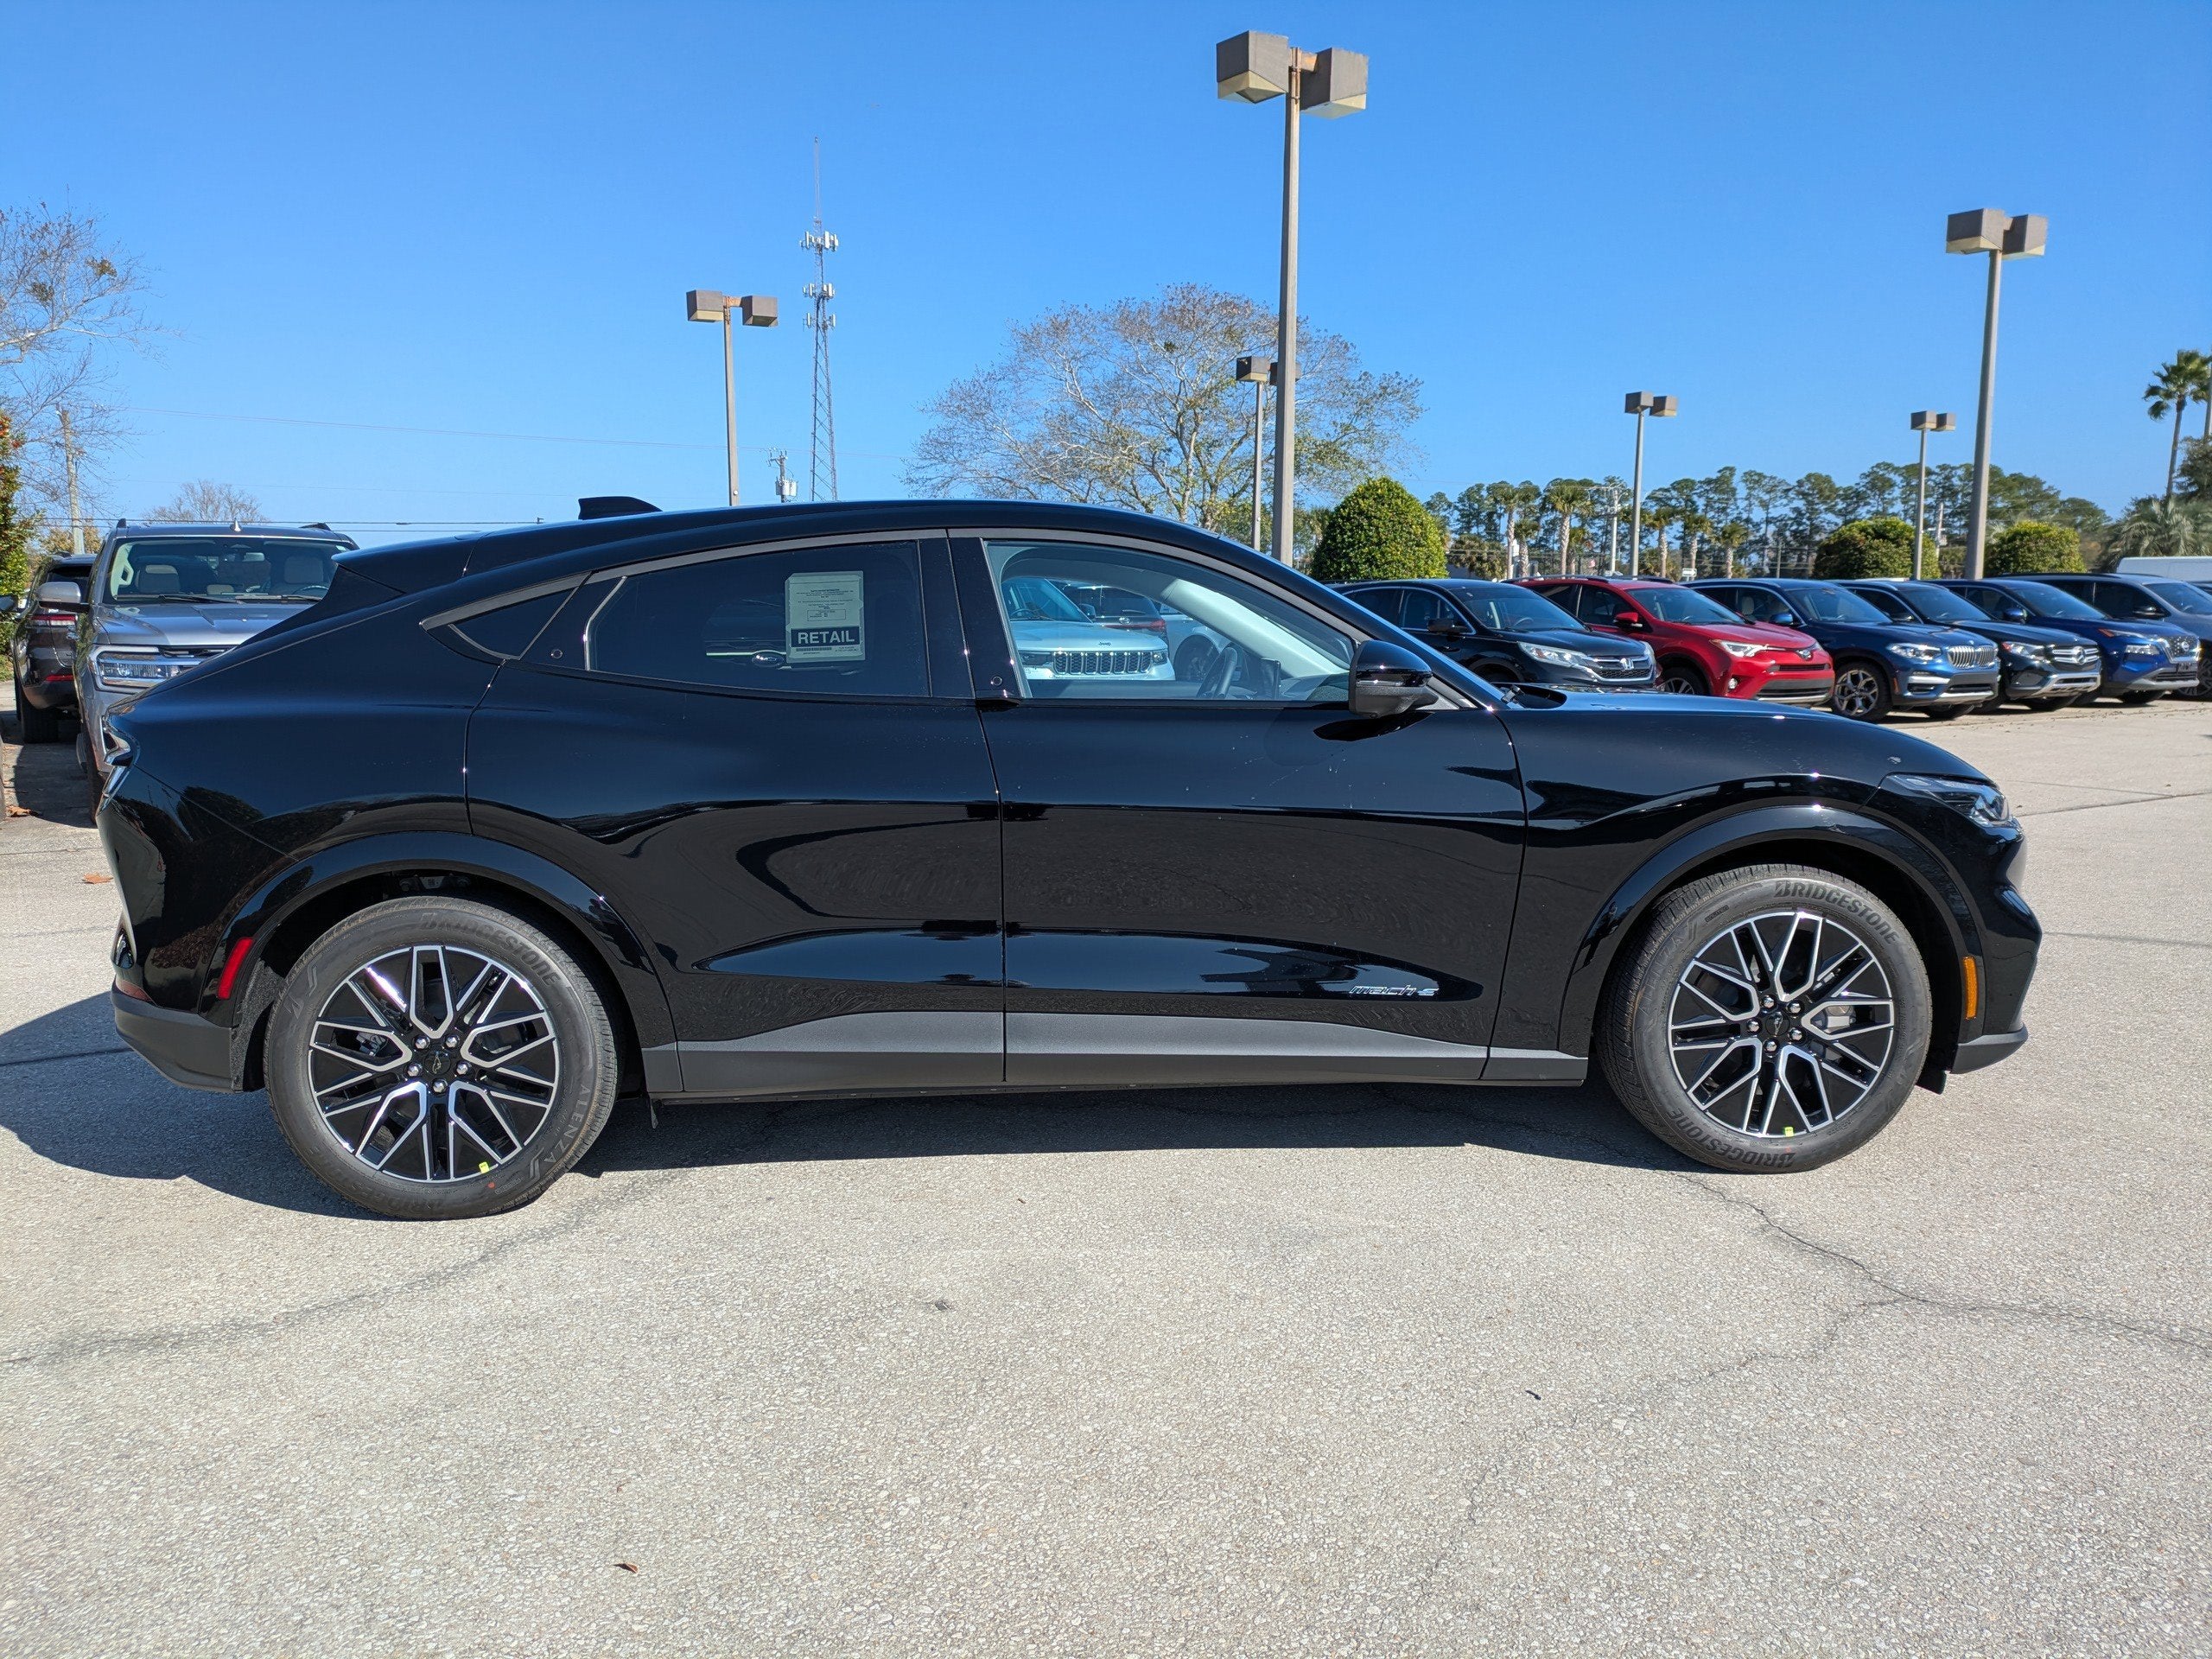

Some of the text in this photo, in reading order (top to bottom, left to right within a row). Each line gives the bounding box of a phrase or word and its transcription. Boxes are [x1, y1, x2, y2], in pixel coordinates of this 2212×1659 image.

[798, 630, 855, 645] RETAIL
[1774, 880, 1900, 944] BRIDGESTONE
[418, 912, 561, 986] BDGESTONE
[1666, 1107, 1796, 1167] BRIDGESTONE
